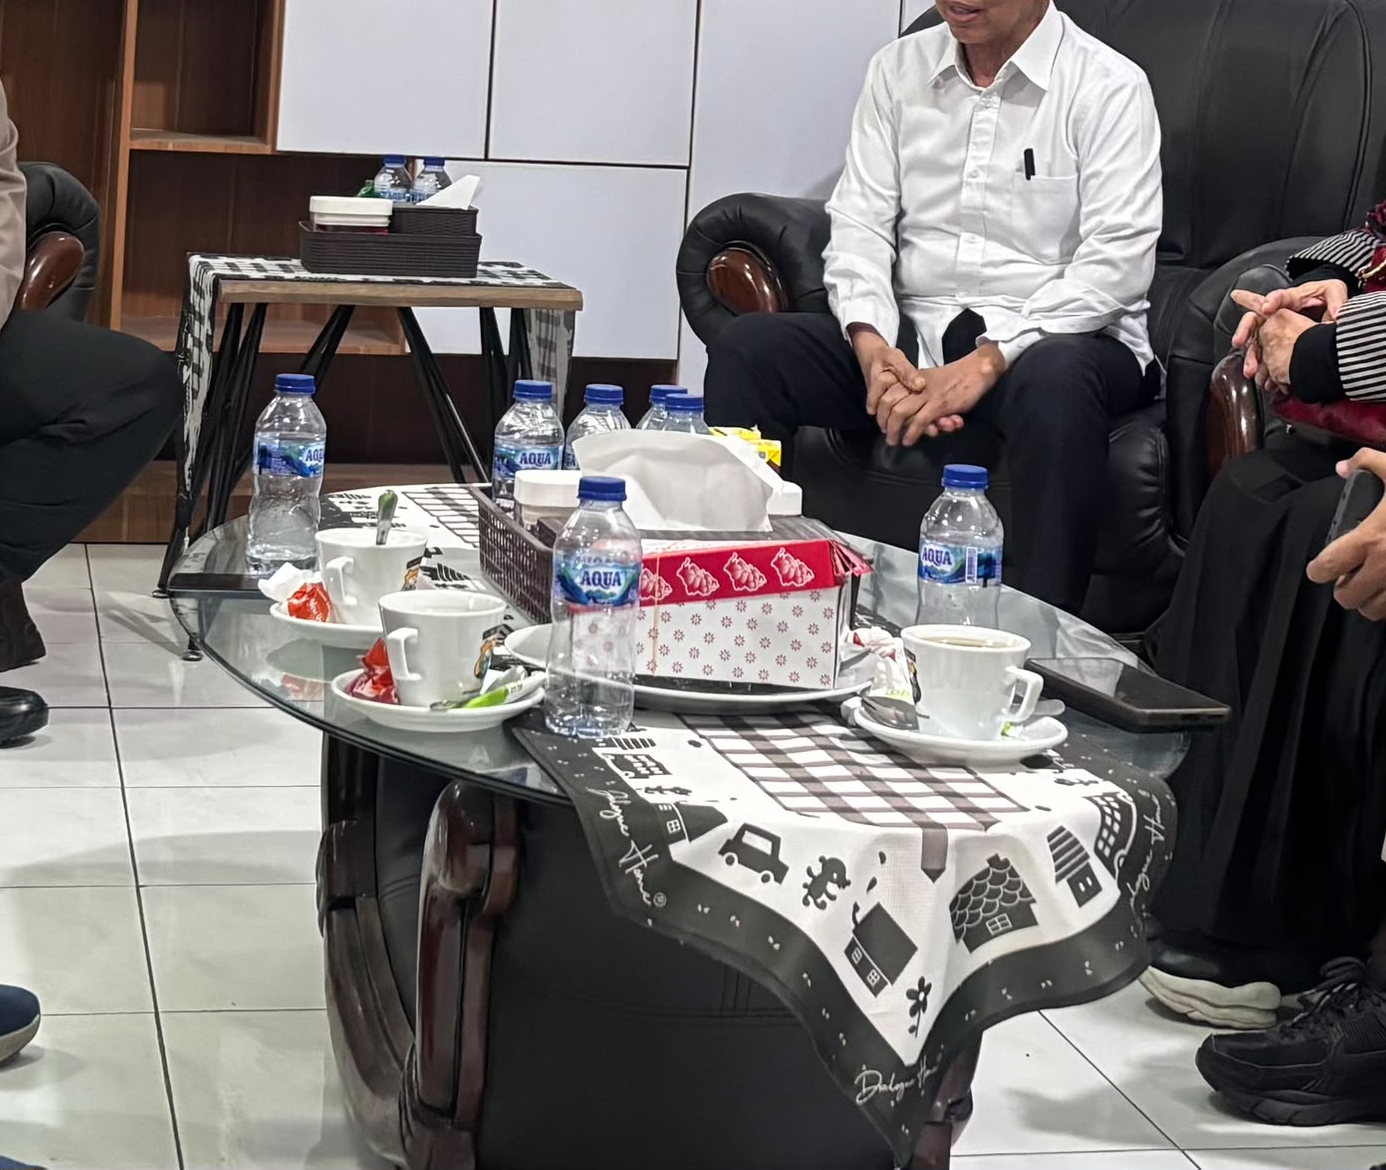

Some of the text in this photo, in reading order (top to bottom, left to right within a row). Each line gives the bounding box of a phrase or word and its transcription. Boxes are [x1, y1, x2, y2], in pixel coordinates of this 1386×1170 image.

[519, 452, 551, 467] AQUA
[922, 546, 953, 567] AQUA
[580, 570, 622, 590] AQUA
